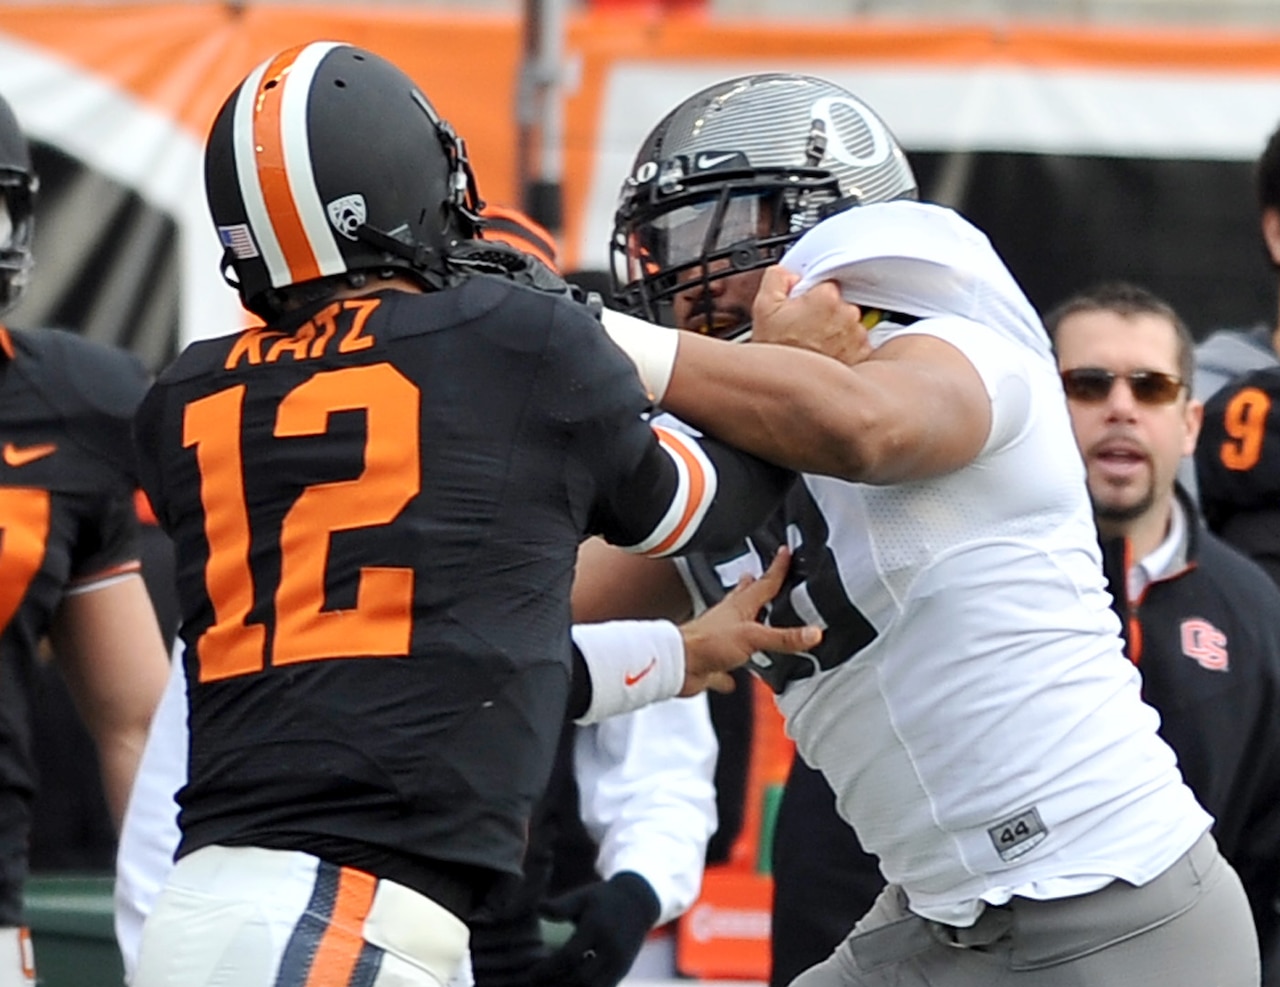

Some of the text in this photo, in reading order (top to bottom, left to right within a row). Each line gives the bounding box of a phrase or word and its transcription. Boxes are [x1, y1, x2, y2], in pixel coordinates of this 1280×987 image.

[224, 299, 381, 370] KATZ
[1220, 387, 1270, 471] 9
[183, 362, 421, 683] 12
[1001, 821, 1029, 843] 44
